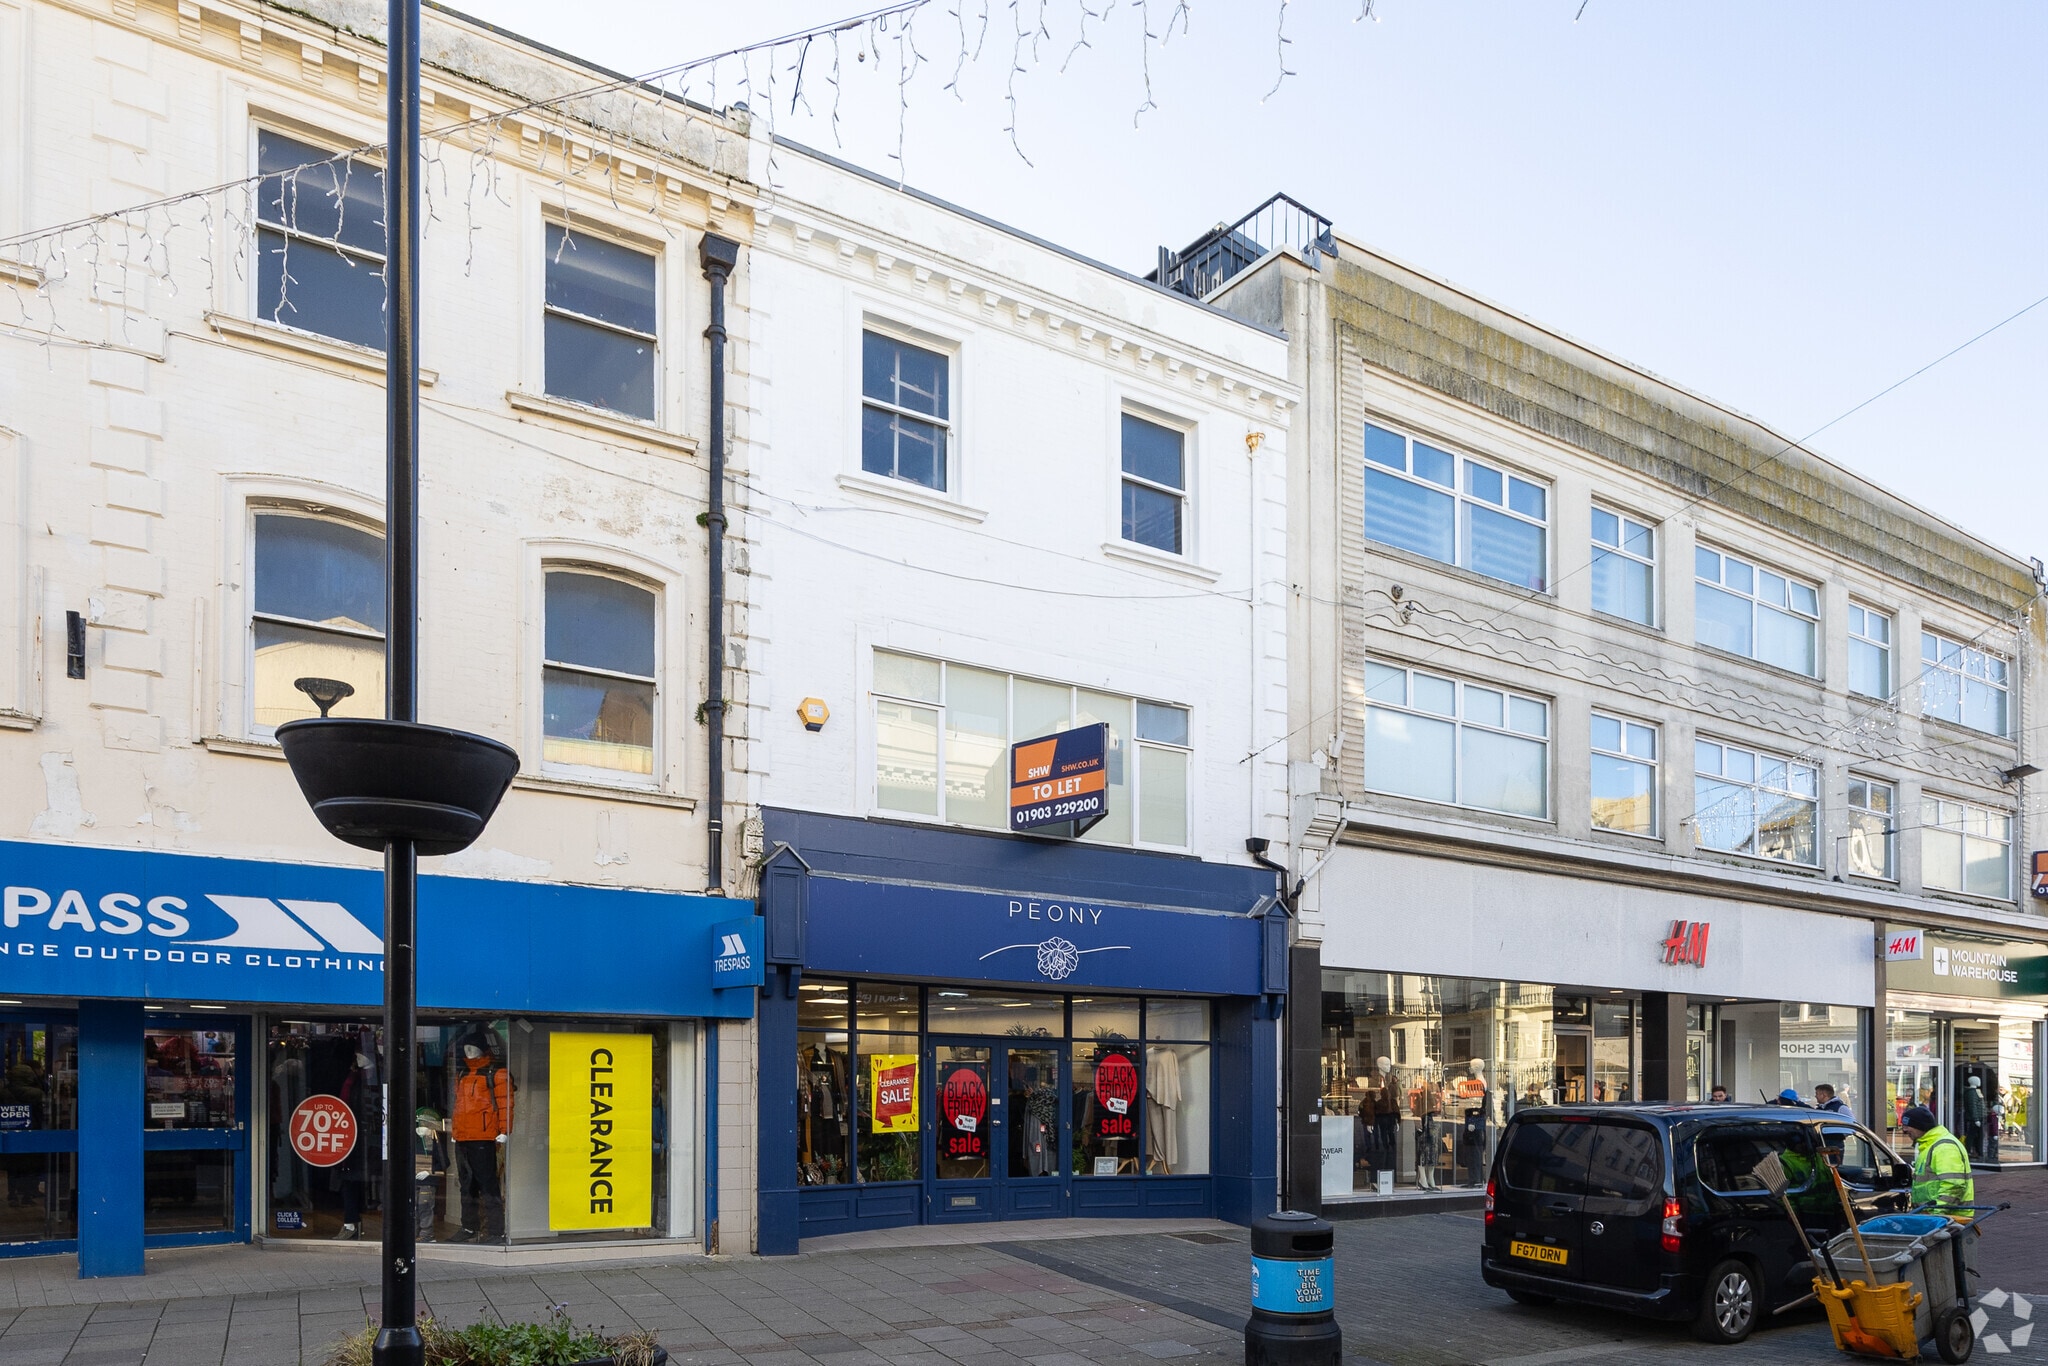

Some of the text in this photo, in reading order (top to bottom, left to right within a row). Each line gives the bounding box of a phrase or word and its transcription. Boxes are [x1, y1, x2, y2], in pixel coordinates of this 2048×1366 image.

[1028, 765, 1050, 778] SHW
[1061, 758, 1099, 773] SHW.CO.UK
[1032, 777, 1082, 800] TO LET
[1016, 797, 1099, 823] 01903 229200
[3, 885, 191, 938] PASS
[1009, 900, 1103, 925] PEONY
[1661, 919, 1710, 969] H&M
[1889, 936, 1917, 954] H&M
[74, 945, 232, 965] OUTDOOR
[245, 954, 385, 972] CLOTHIN
[714, 955, 751, 973] TRESPASS
[1951, 949, 2007, 967] MOUNTAIN
[1951, 965, 2018, 983] WAREHOUSE
[1099, 1065, 1134, 1083] BLACK
[881, 1087, 911, 1105] SALE
[947, 1081, 983, 1099] BLACK
[1099, 1083, 1134, 1100] FRIDAY
[947, 1099, 982, 1117] FRIDAY
[299, 1109, 349, 1133] 70%
[1101, 1114, 1132, 1134] sale
[590, 1048, 613, 1214] CLEARANCE
[949, 1132, 981, 1153] sale
[1516, 1243, 1539, 1258] FG71
[1298, 1268, 1320, 1276] TIME
[1296, 1288, 1322, 1296] YOUR
